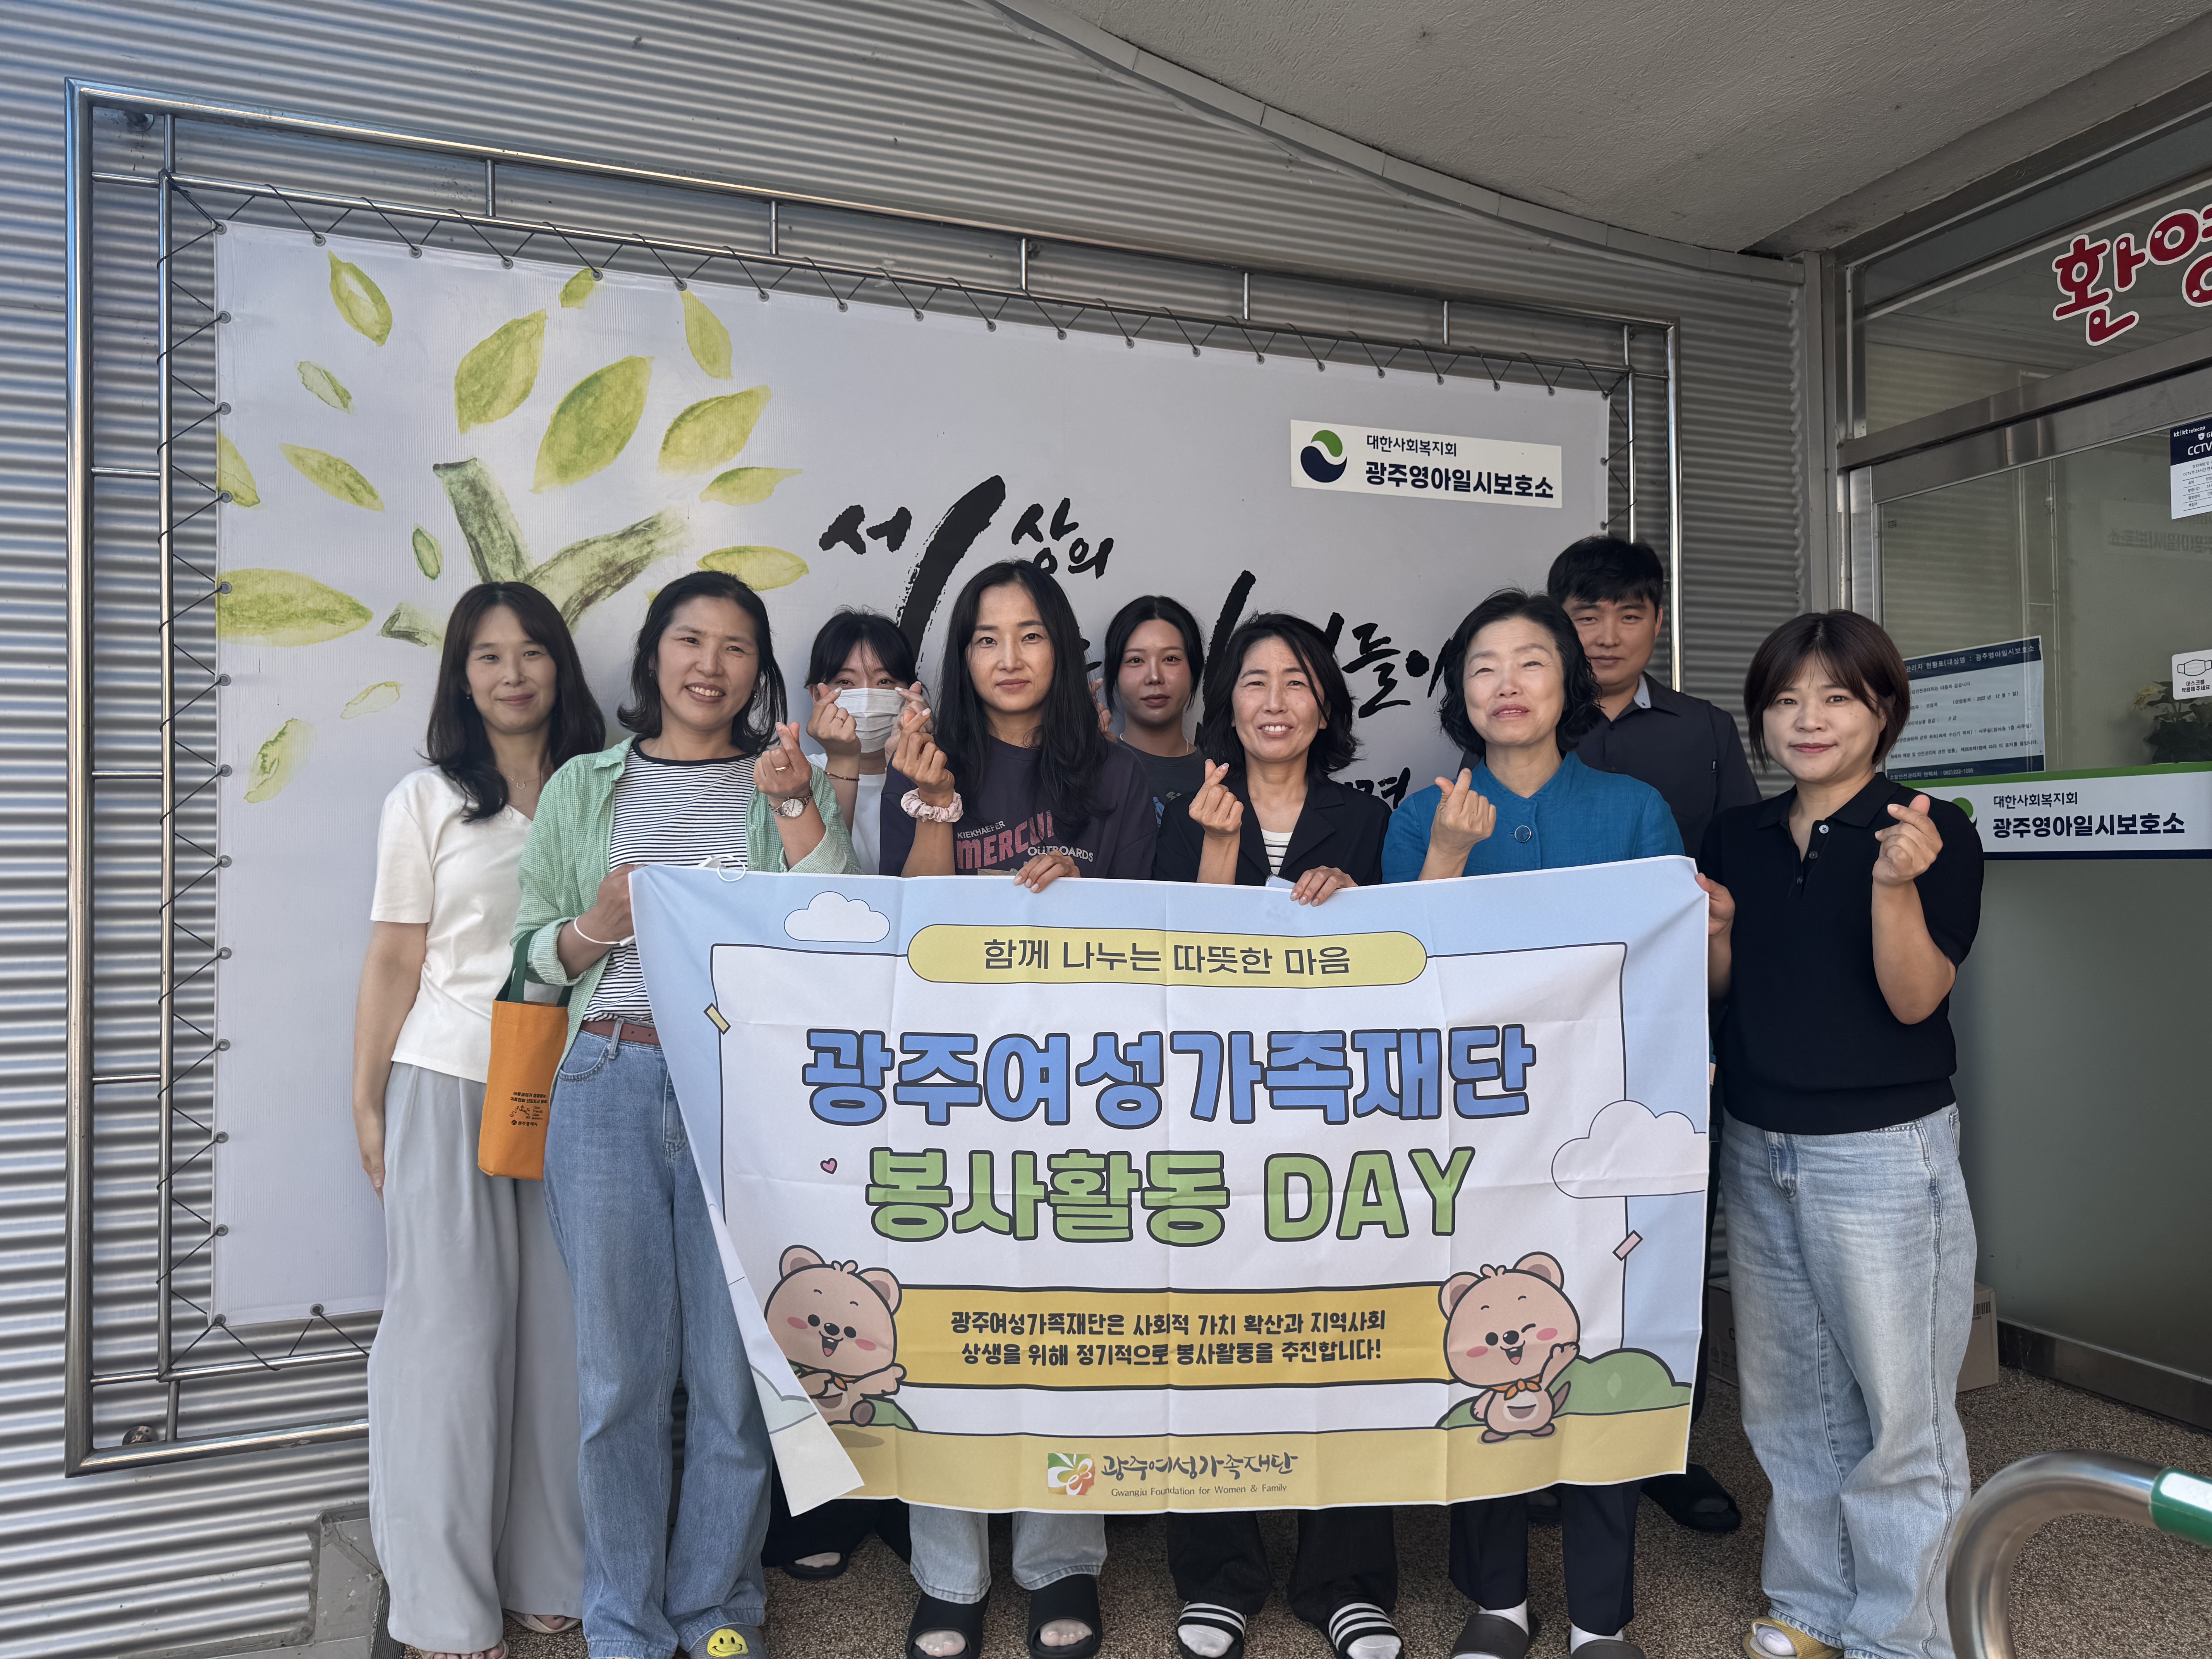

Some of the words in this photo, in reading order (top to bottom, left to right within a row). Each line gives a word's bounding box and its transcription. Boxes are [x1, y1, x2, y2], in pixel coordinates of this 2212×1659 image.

[1366, 435, 1457, 457] 대한사회복지회
[1365, 460, 1554, 499] 광주영아일시보호소
[819, 474, 1114, 678] 세상의
[1975, 645, 2035, 661] 광주영아일시보호소
[1993, 792, 2078, 809] 대한사회복지회
[957, 820, 1006, 839] KIEKHAEFER
[1992, 812, 2186, 838] 광주영아일시보호소
[984, 938, 1049, 970] 함께
[1063, 941, 1161, 973] 나누는
[1173, 945, 1272, 974] 따뜻한
[1285, 946, 1351, 976] 마음
[802, 1024, 1537, 1130] 광주여성가족재단
[866, 1147, 1231, 1246] 봉사활동
[1264, 1146, 1477, 1242] DAY
[951, 1311, 1125, 1336] 광주여성가족재단은
[1133, 1313, 1189, 1336] 사회적
[1198, 1314, 1236, 1335] 가치
[1243, 1313, 1304, 1335] 확산과
[1310, 1310, 1386, 1333] 지역사회
[961, 1343, 1021, 1365] 상생을
[1028, 1344, 1068, 1366] 위해
[1077, 1343, 1169, 1366] 정기적으로
[1177, 1342, 1273, 1365] 봉사활동을
[1281, 1338, 1381, 1363] 추진합니다!
[1101, 1451, 1298, 1481] 광주여성가족재단
[1111, 1488, 1147, 1497] Gwangju
[1151, 1486, 1195, 1496] Foundation
[1199, 1486, 1211, 1495] for
[1214, 1486, 1246, 1494] Women
[1262, 1483, 1288, 1492] Family
